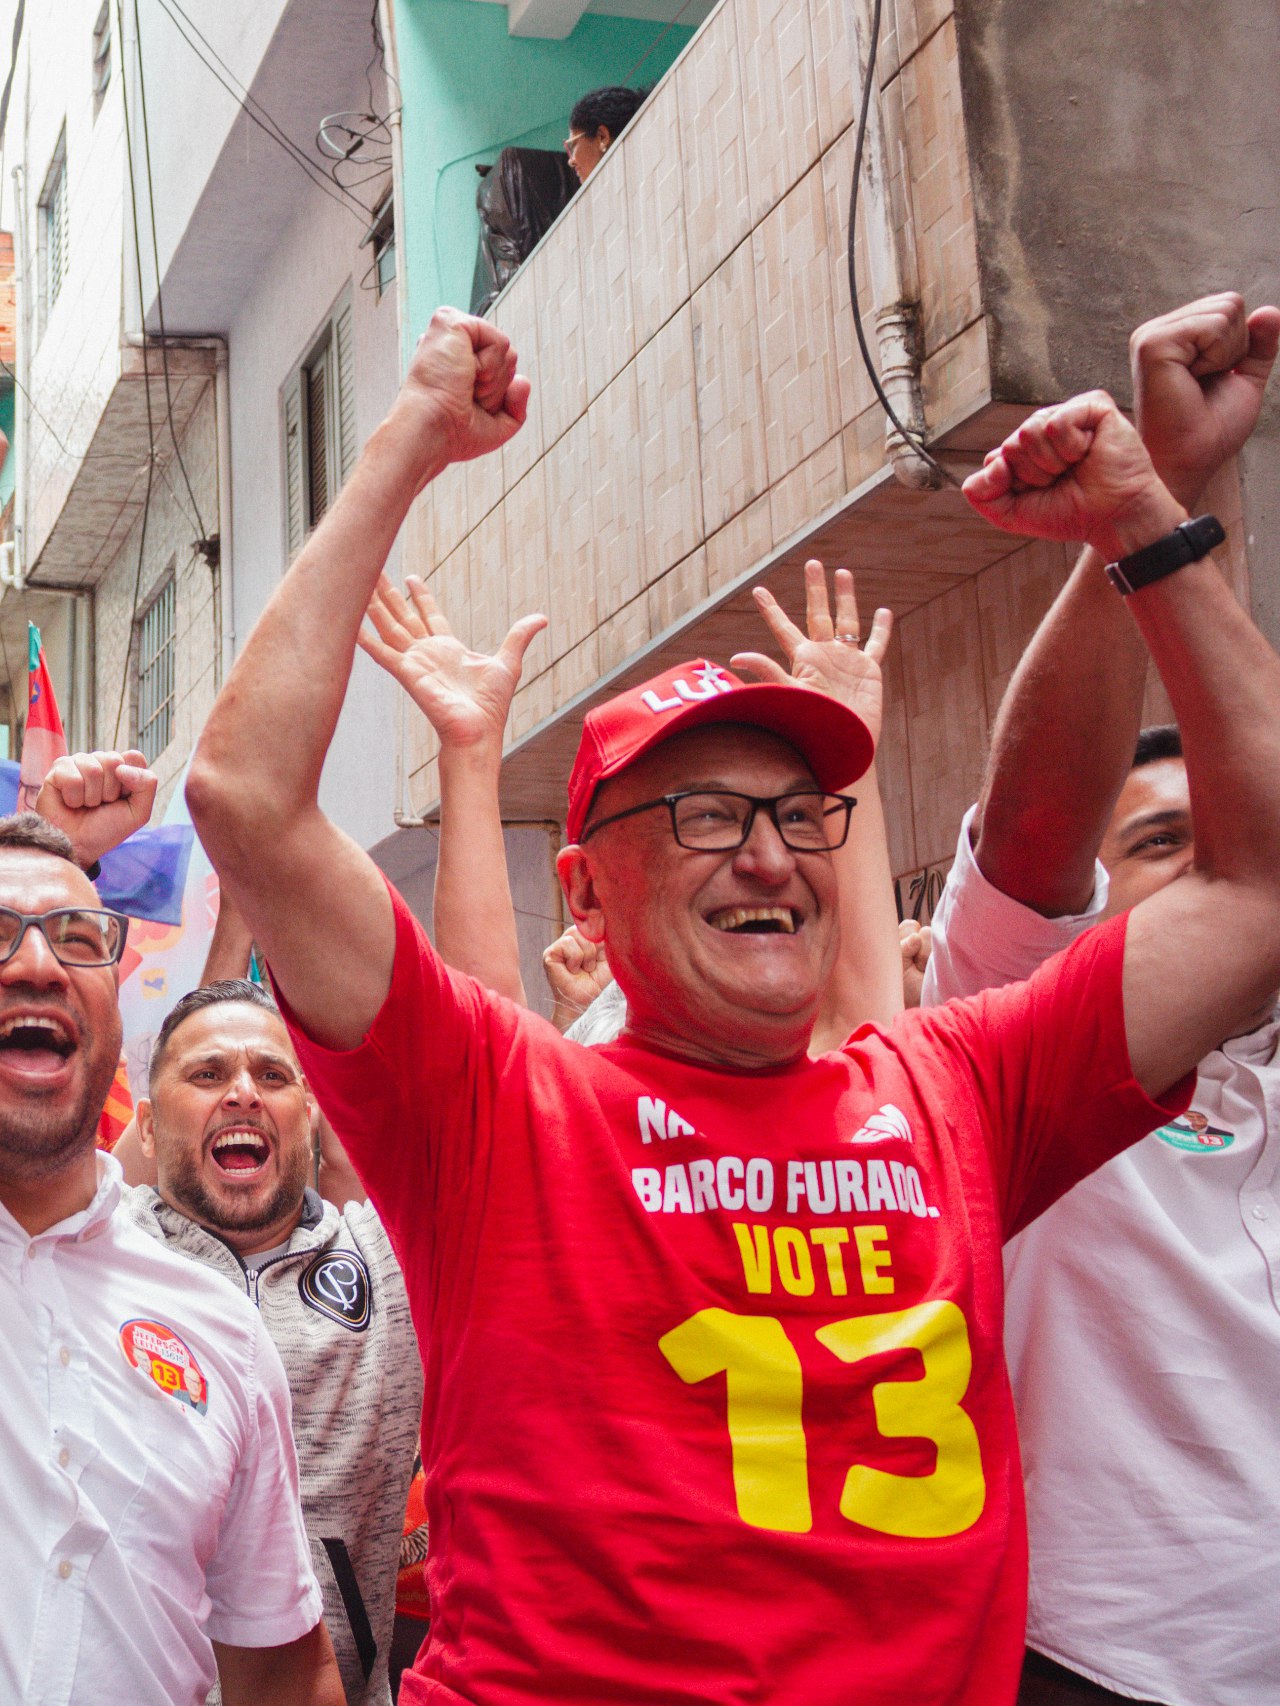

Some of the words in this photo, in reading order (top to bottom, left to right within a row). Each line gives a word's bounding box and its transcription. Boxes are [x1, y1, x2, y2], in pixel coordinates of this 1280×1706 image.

[631, 1156, 774, 1214] BARCO
[786, 1159, 941, 1219] FURADO.
[732, 1222, 895, 1297] VOTE
[154, 1364, 179, 1387] 13
[658, 1299, 985, 1537] 13
